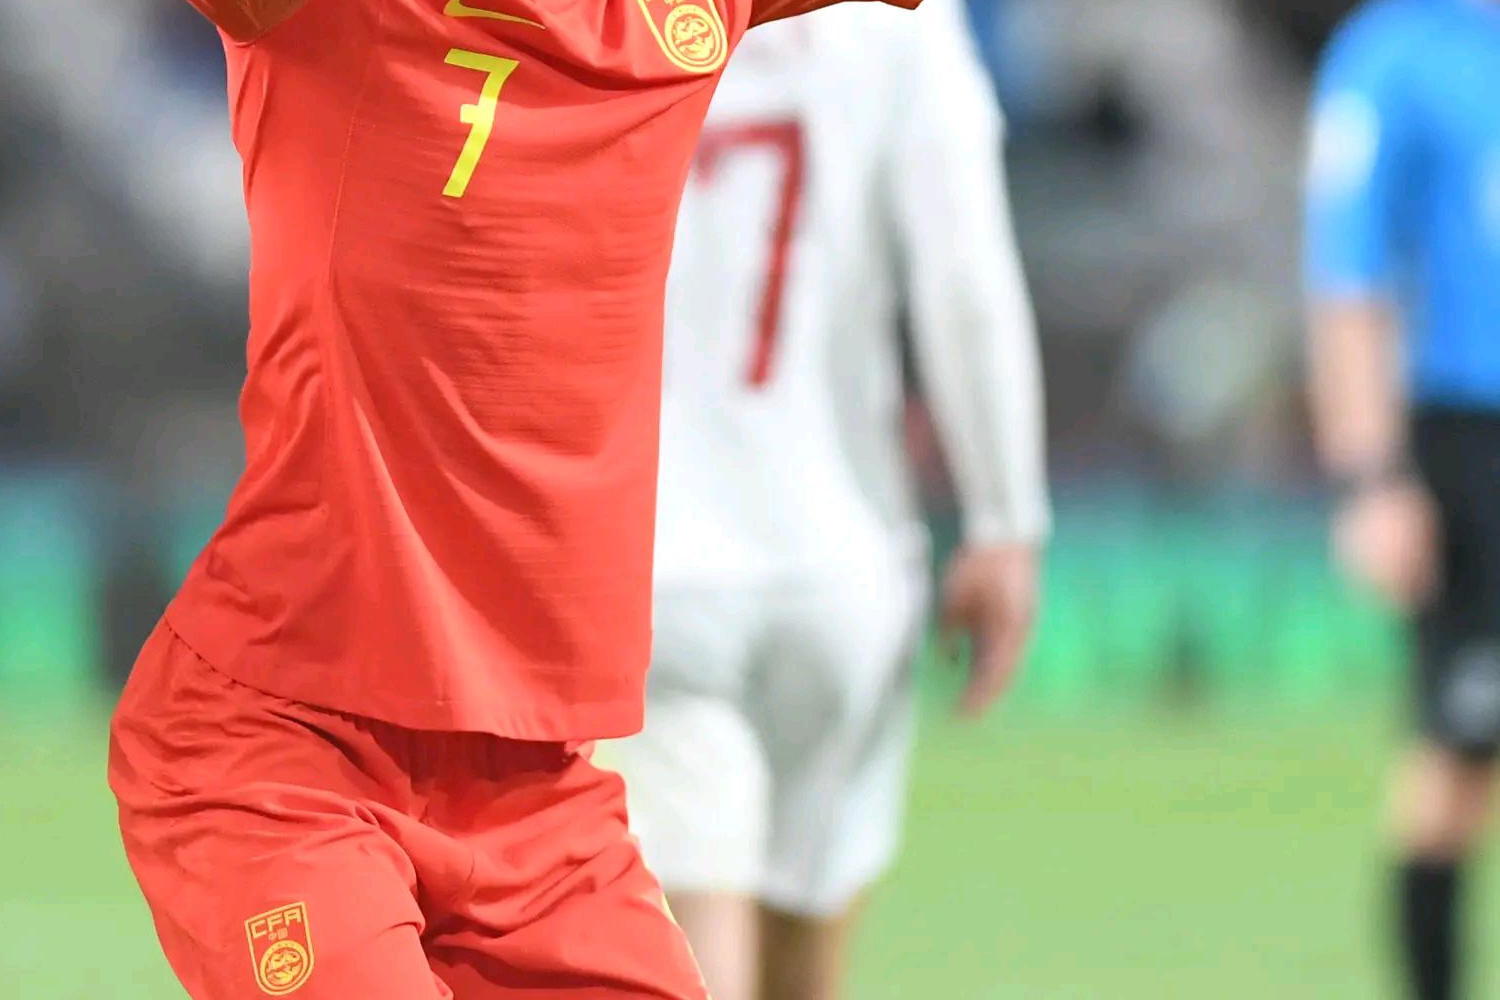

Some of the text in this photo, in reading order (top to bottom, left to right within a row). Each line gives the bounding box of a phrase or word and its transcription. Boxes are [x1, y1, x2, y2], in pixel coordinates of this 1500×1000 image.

[442, 48, 520, 198] 7
[693, 115, 806, 388] 7
[251, 907, 302, 938] CFA
